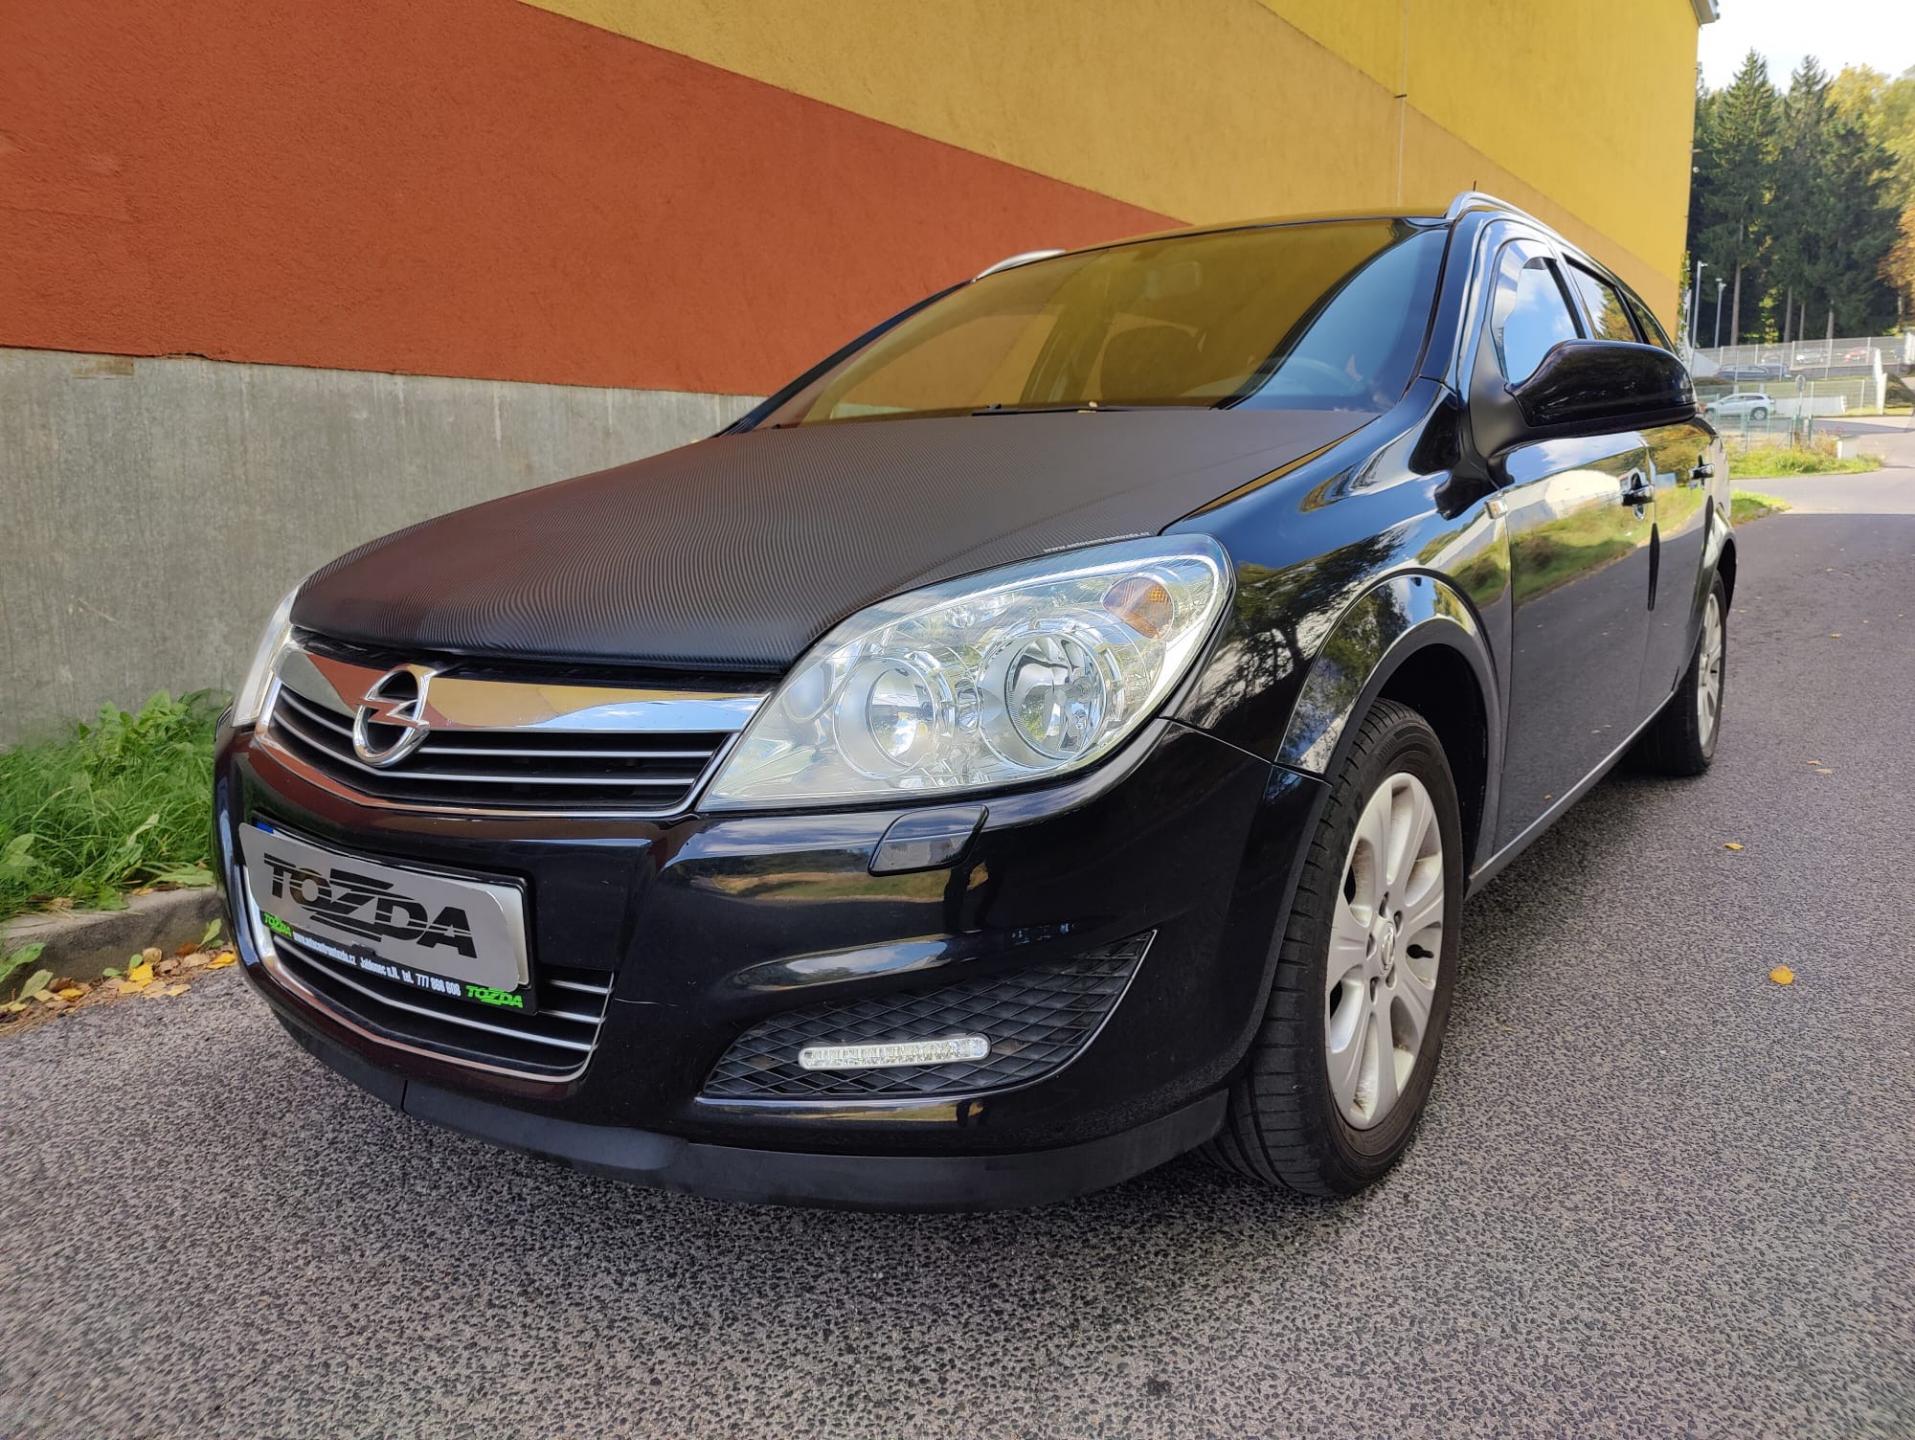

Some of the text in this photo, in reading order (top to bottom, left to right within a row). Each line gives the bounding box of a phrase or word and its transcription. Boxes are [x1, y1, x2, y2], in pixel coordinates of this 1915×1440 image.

[263, 852, 478, 959] TOZDA
[262, 912, 293, 938] TOZDA
[415, 973, 429, 989] 777
[465, 984, 524, 1009] TOZDA
